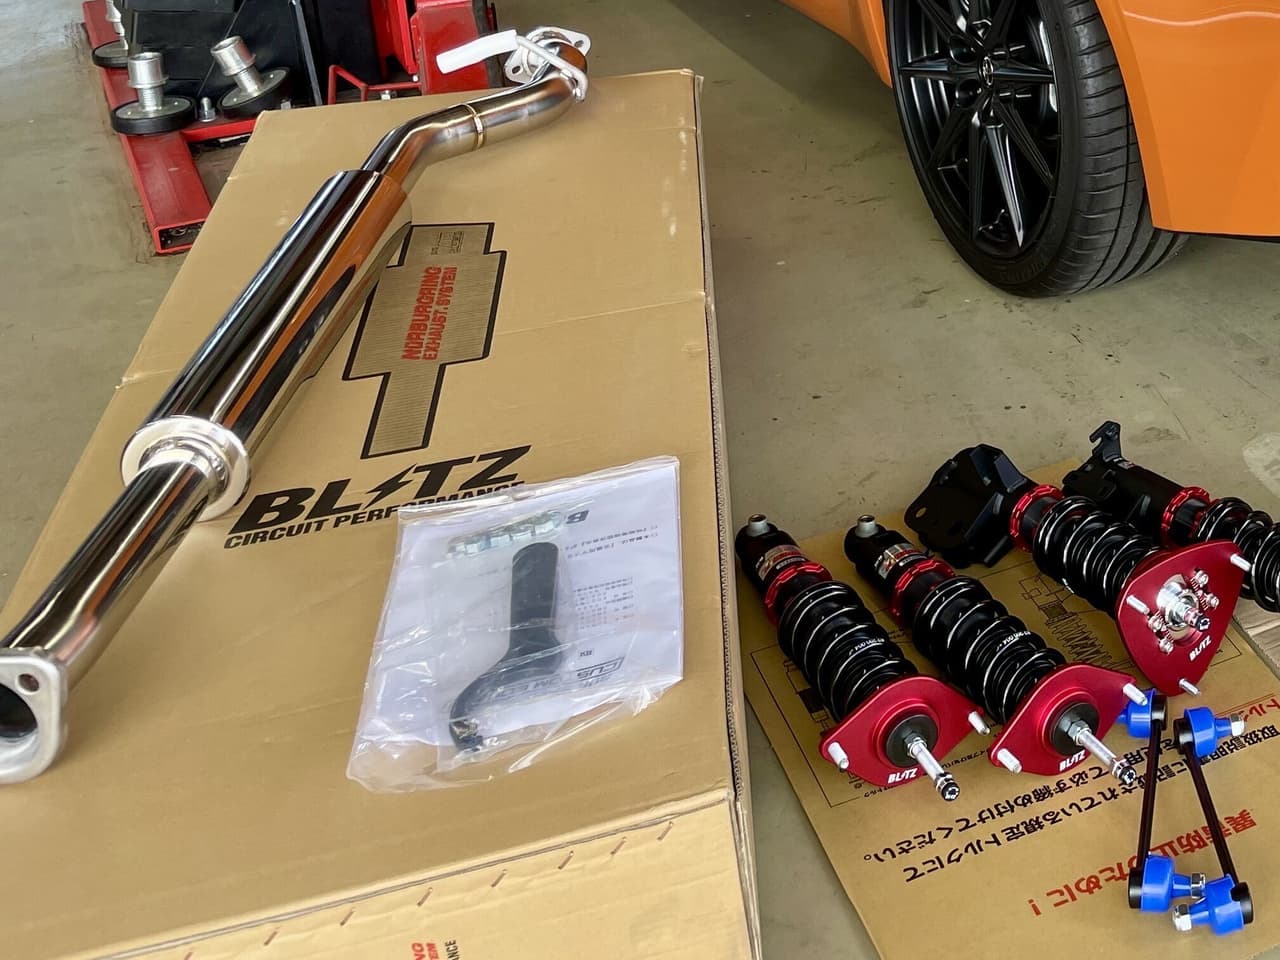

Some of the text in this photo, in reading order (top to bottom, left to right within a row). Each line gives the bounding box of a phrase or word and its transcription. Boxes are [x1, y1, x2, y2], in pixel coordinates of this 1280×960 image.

[228, 444, 532, 535] BLITZ
[223, 518, 327, 549] CIRCUIT
[1190, 635, 1212, 662] BLITZ
[1059, 750, 1087, 772] BLITZ
[887, 767, 918, 784] BLITZ
